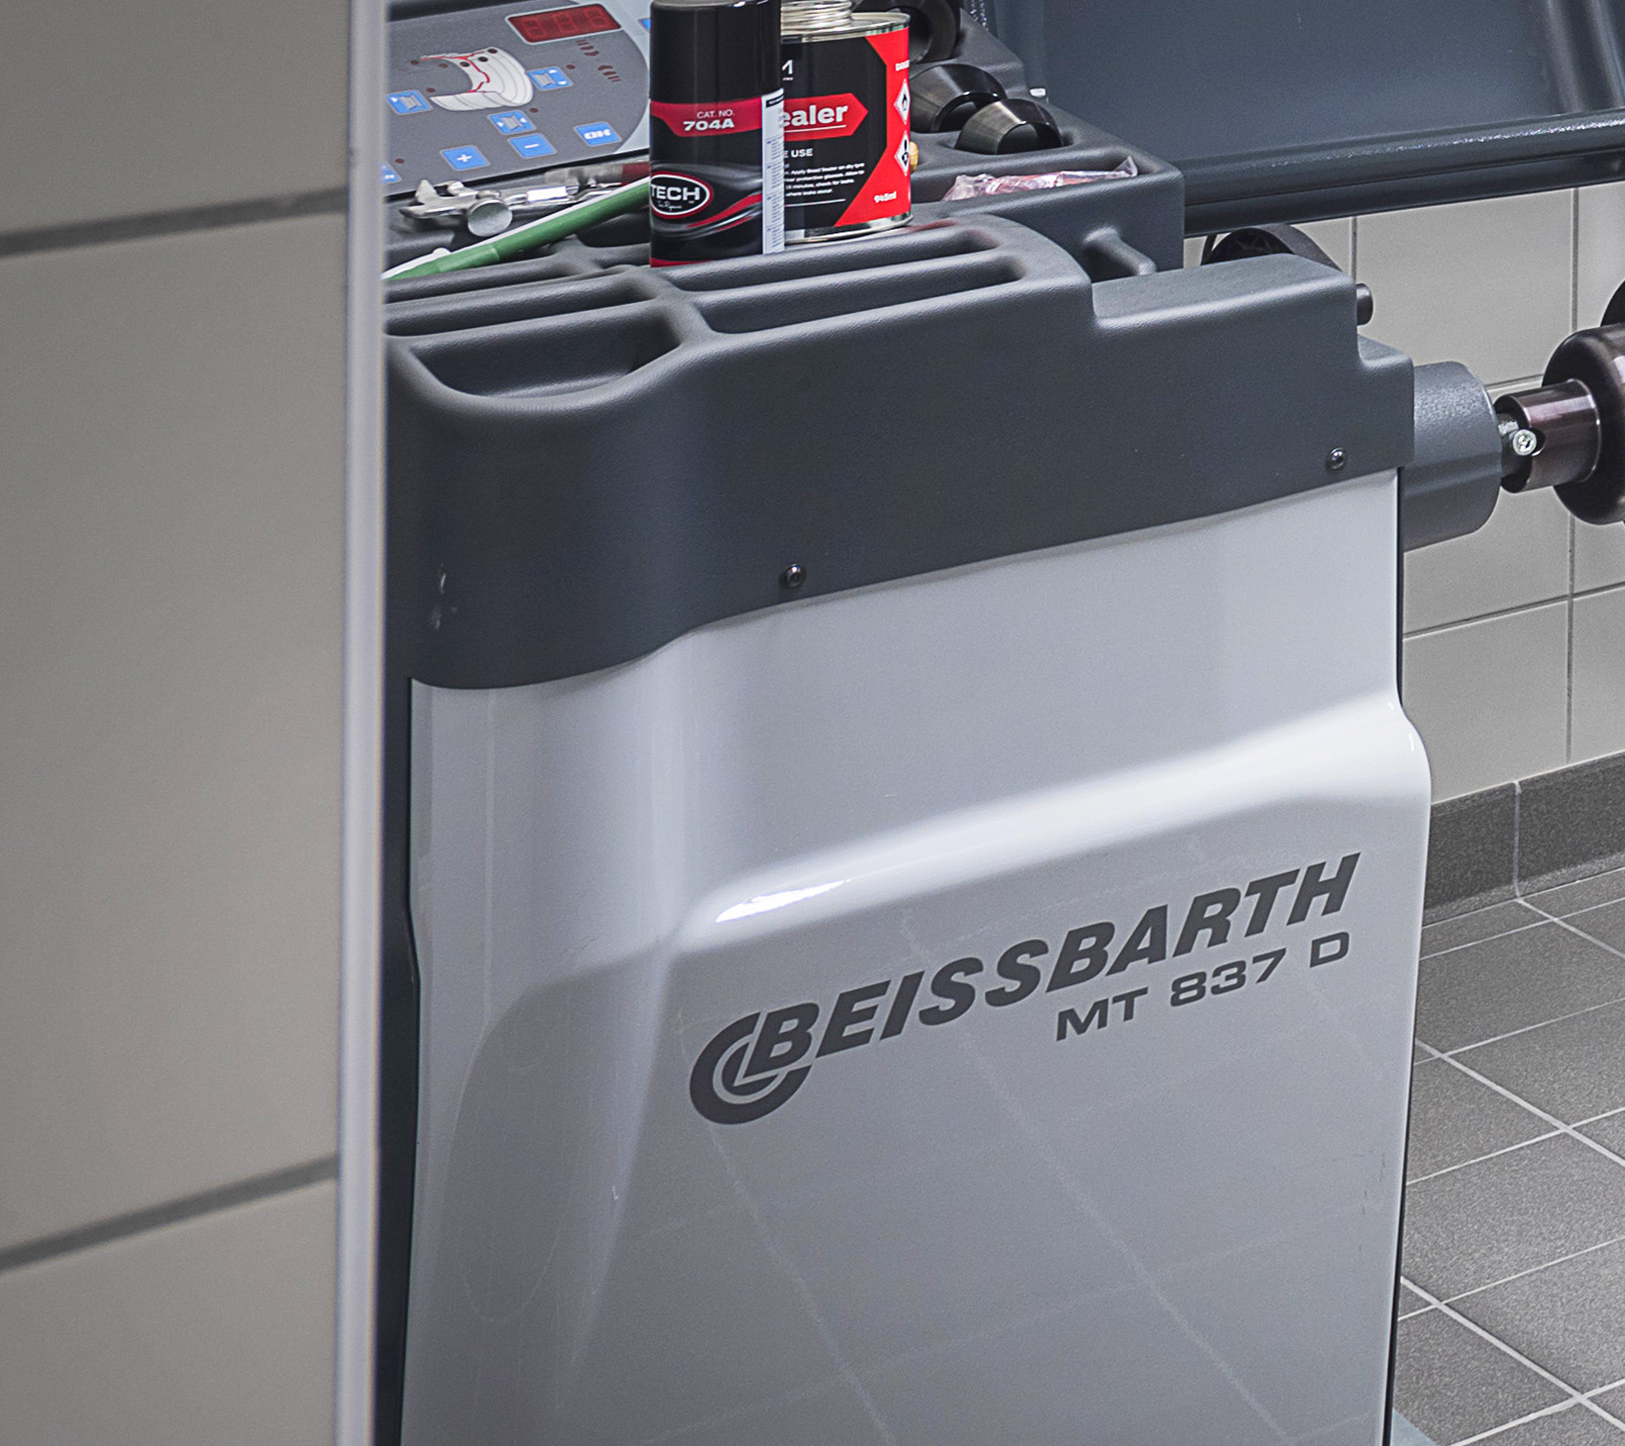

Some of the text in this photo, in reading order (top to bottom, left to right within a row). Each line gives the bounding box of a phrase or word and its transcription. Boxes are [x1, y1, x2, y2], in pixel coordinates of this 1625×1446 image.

[697, 109, 735, 119] CAT. NO.
[782, 104, 848, 127] ealer
[683, 119, 735, 131] 704A
[791, 148, 813, 158] USE
[650, 184, 700, 201] TECH
[735, 852, 1361, 1089] BEISSBARTH
[1055, 931, 1350, 1042] MT 837 D
